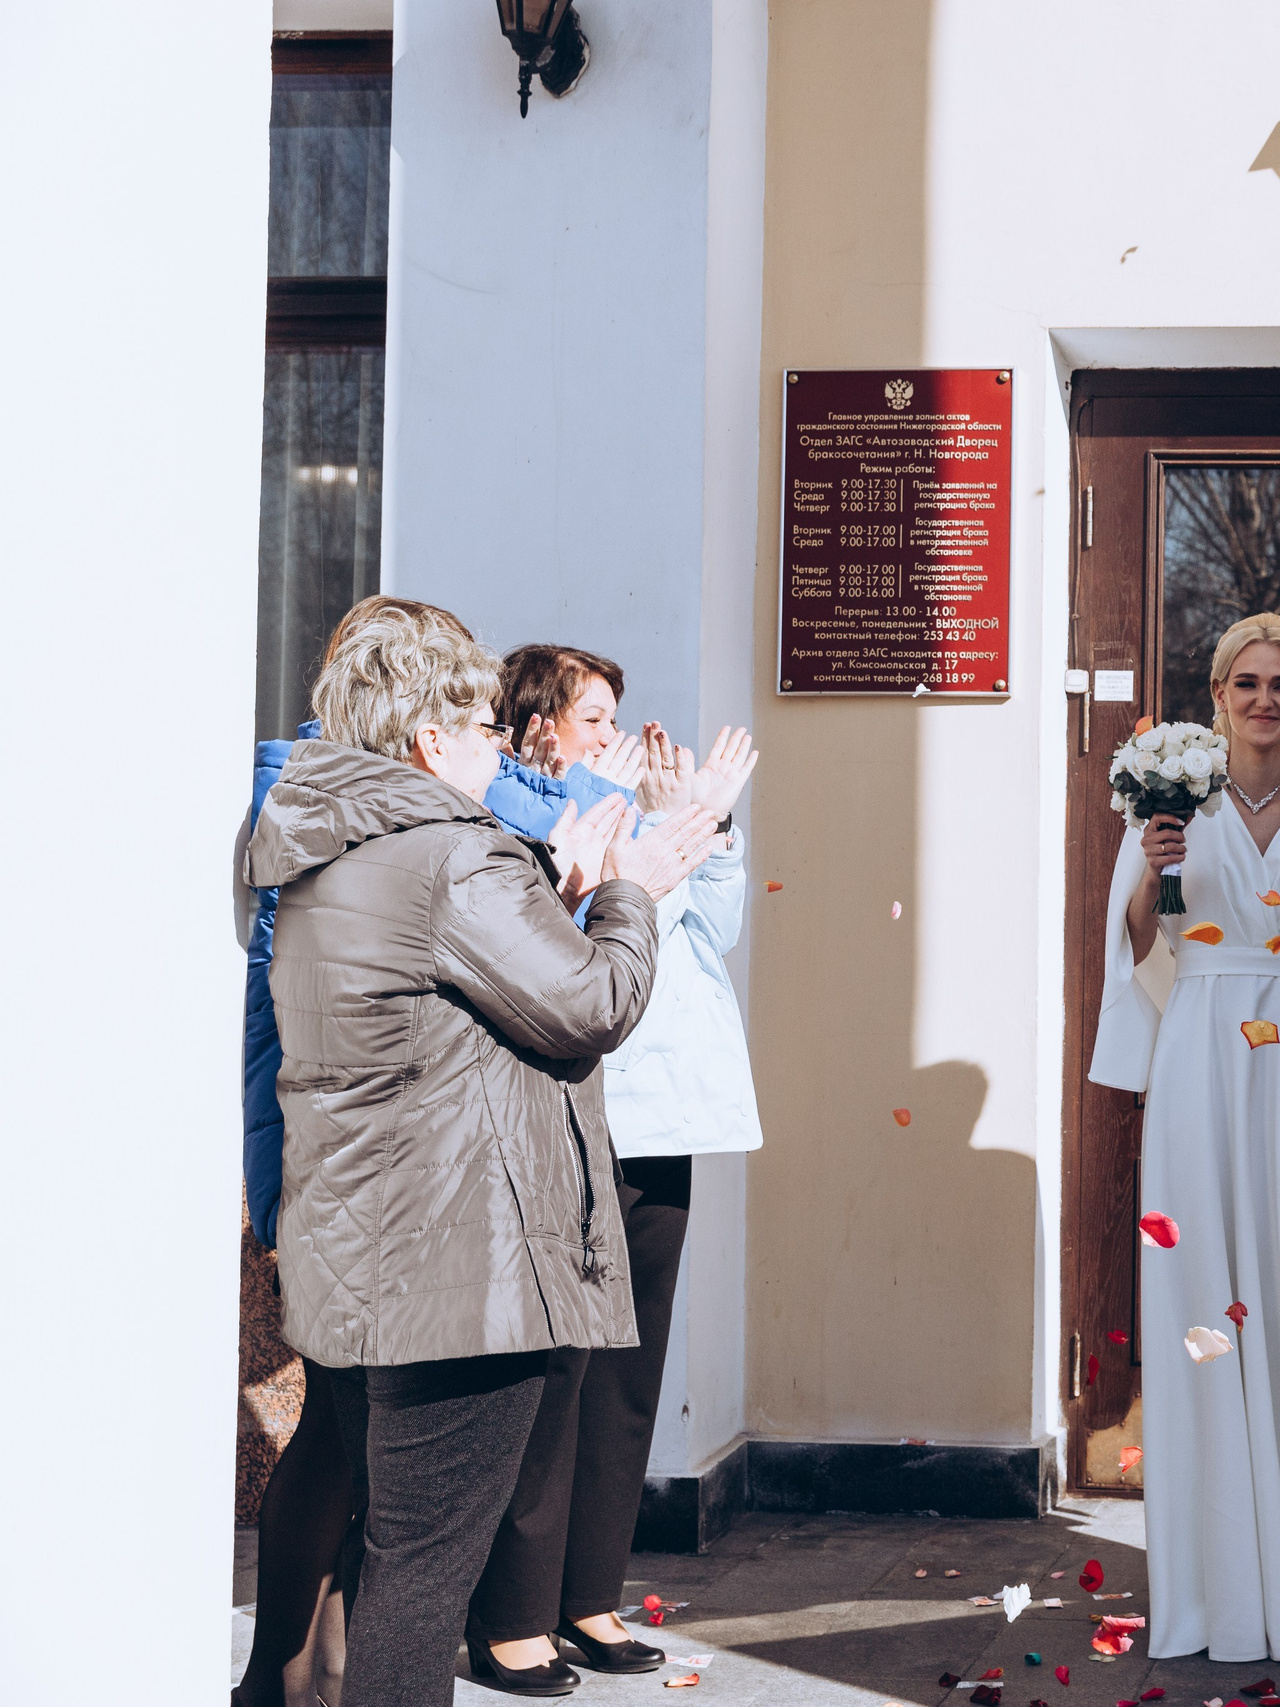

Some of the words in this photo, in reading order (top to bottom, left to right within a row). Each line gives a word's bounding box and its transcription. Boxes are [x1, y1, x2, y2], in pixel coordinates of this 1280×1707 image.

[829, 412, 862, 421] Главное
[864, 414, 914, 423] управление
[915, 414, 945, 422] записи
[797, 424, 854, 432] гражданского
[900, 422, 966, 432] Нижегородской
[967, 422, 1002, 431] области
[800, 436, 832, 446] Отдел
[836, 435, 863, 446] ЗАГС
[866, 436, 955, 446] «Автозаводский
[956, 435, 998, 448] Дворец
[808, 449, 901, 461] бракосочетания»
[904, 451, 911, 459] г.
[914, 449, 925, 458] Н.
[929, 449, 989, 461] Новгорода
[860, 463, 892, 473] Режим
[895, 463, 935, 475] работы:
[794, 479, 833, 492] Вторник
[841, 479, 897, 489] 9.00-17.30
[942, 481, 985, 490] заявлений
[794, 490, 824, 503] Среда
[841, 490, 897, 501] 9.00-17.30
[920, 492, 990, 501] государственную
[794, 502, 830, 514] Четверг
[841, 502, 896, 512] 9.00-17.30
[915, 500, 968, 511] регистрацию
[969, 500, 995, 511] брака
[915, 517, 984, 528] Государственная
[793, 525, 831, 537] Вторник
[840, 525, 896, 535] 9.00-17.00
[910, 529, 961, 538] регистрация
[963, 528, 989, 538] брака
[793, 536, 823, 548] Среда
[840, 537, 895, 547] 9.00-17.00
[916, 538, 989, 547] неторжественной
[925, 546, 973, 556] обстановке
[792, 564, 829, 576] Четверг
[915, 562, 983, 572] Государственная
[792, 575, 831, 588] Пятница
[909, 572, 961, 583] регистрация
[962, 572, 988, 583] брака
[792, 587, 831, 599] Суббота
[839, 587, 895, 597] 9.00-16.00
[920, 584, 983, 592] торжественной
[924, 592, 972, 601] обстановке
[835, 606, 882, 618] Перерыв:
[886, 606, 916, 616] 13.00
[926, 606, 957, 616] 14.00
[792, 618, 859, 629] Воскресенье,
[861, 620, 927, 630] понедельник
[936, 617, 999, 631] ВЫХОДНОЙ
[814, 631, 872, 640] контактный
[874, 630, 921, 642] телефон:
[924, 630, 943, 641] 253
[946, 630, 960, 641] 43
[962, 630, 976, 641] 40
[792, 648, 823, 659] Архив
[826, 651, 859, 661] отдела
[863, 648, 888, 657] ЗАГС
[890, 650, 942, 660] находится
[944, 651, 957, 659] по
[959, 651, 998, 661] адресу:
[832, 662, 845, 671] ул.
[849, 659, 926, 669] Комсомольская
[932, 662, 942, 670] д.
[945, 659, 958, 670] 17
[813, 674, 871, 682] контактный
[873, 673, 920, 686] телефон:
[922, 673, 942, 683] 268
[946, 673, 959, 683] 18
[961, 673, 975, 683] 99
